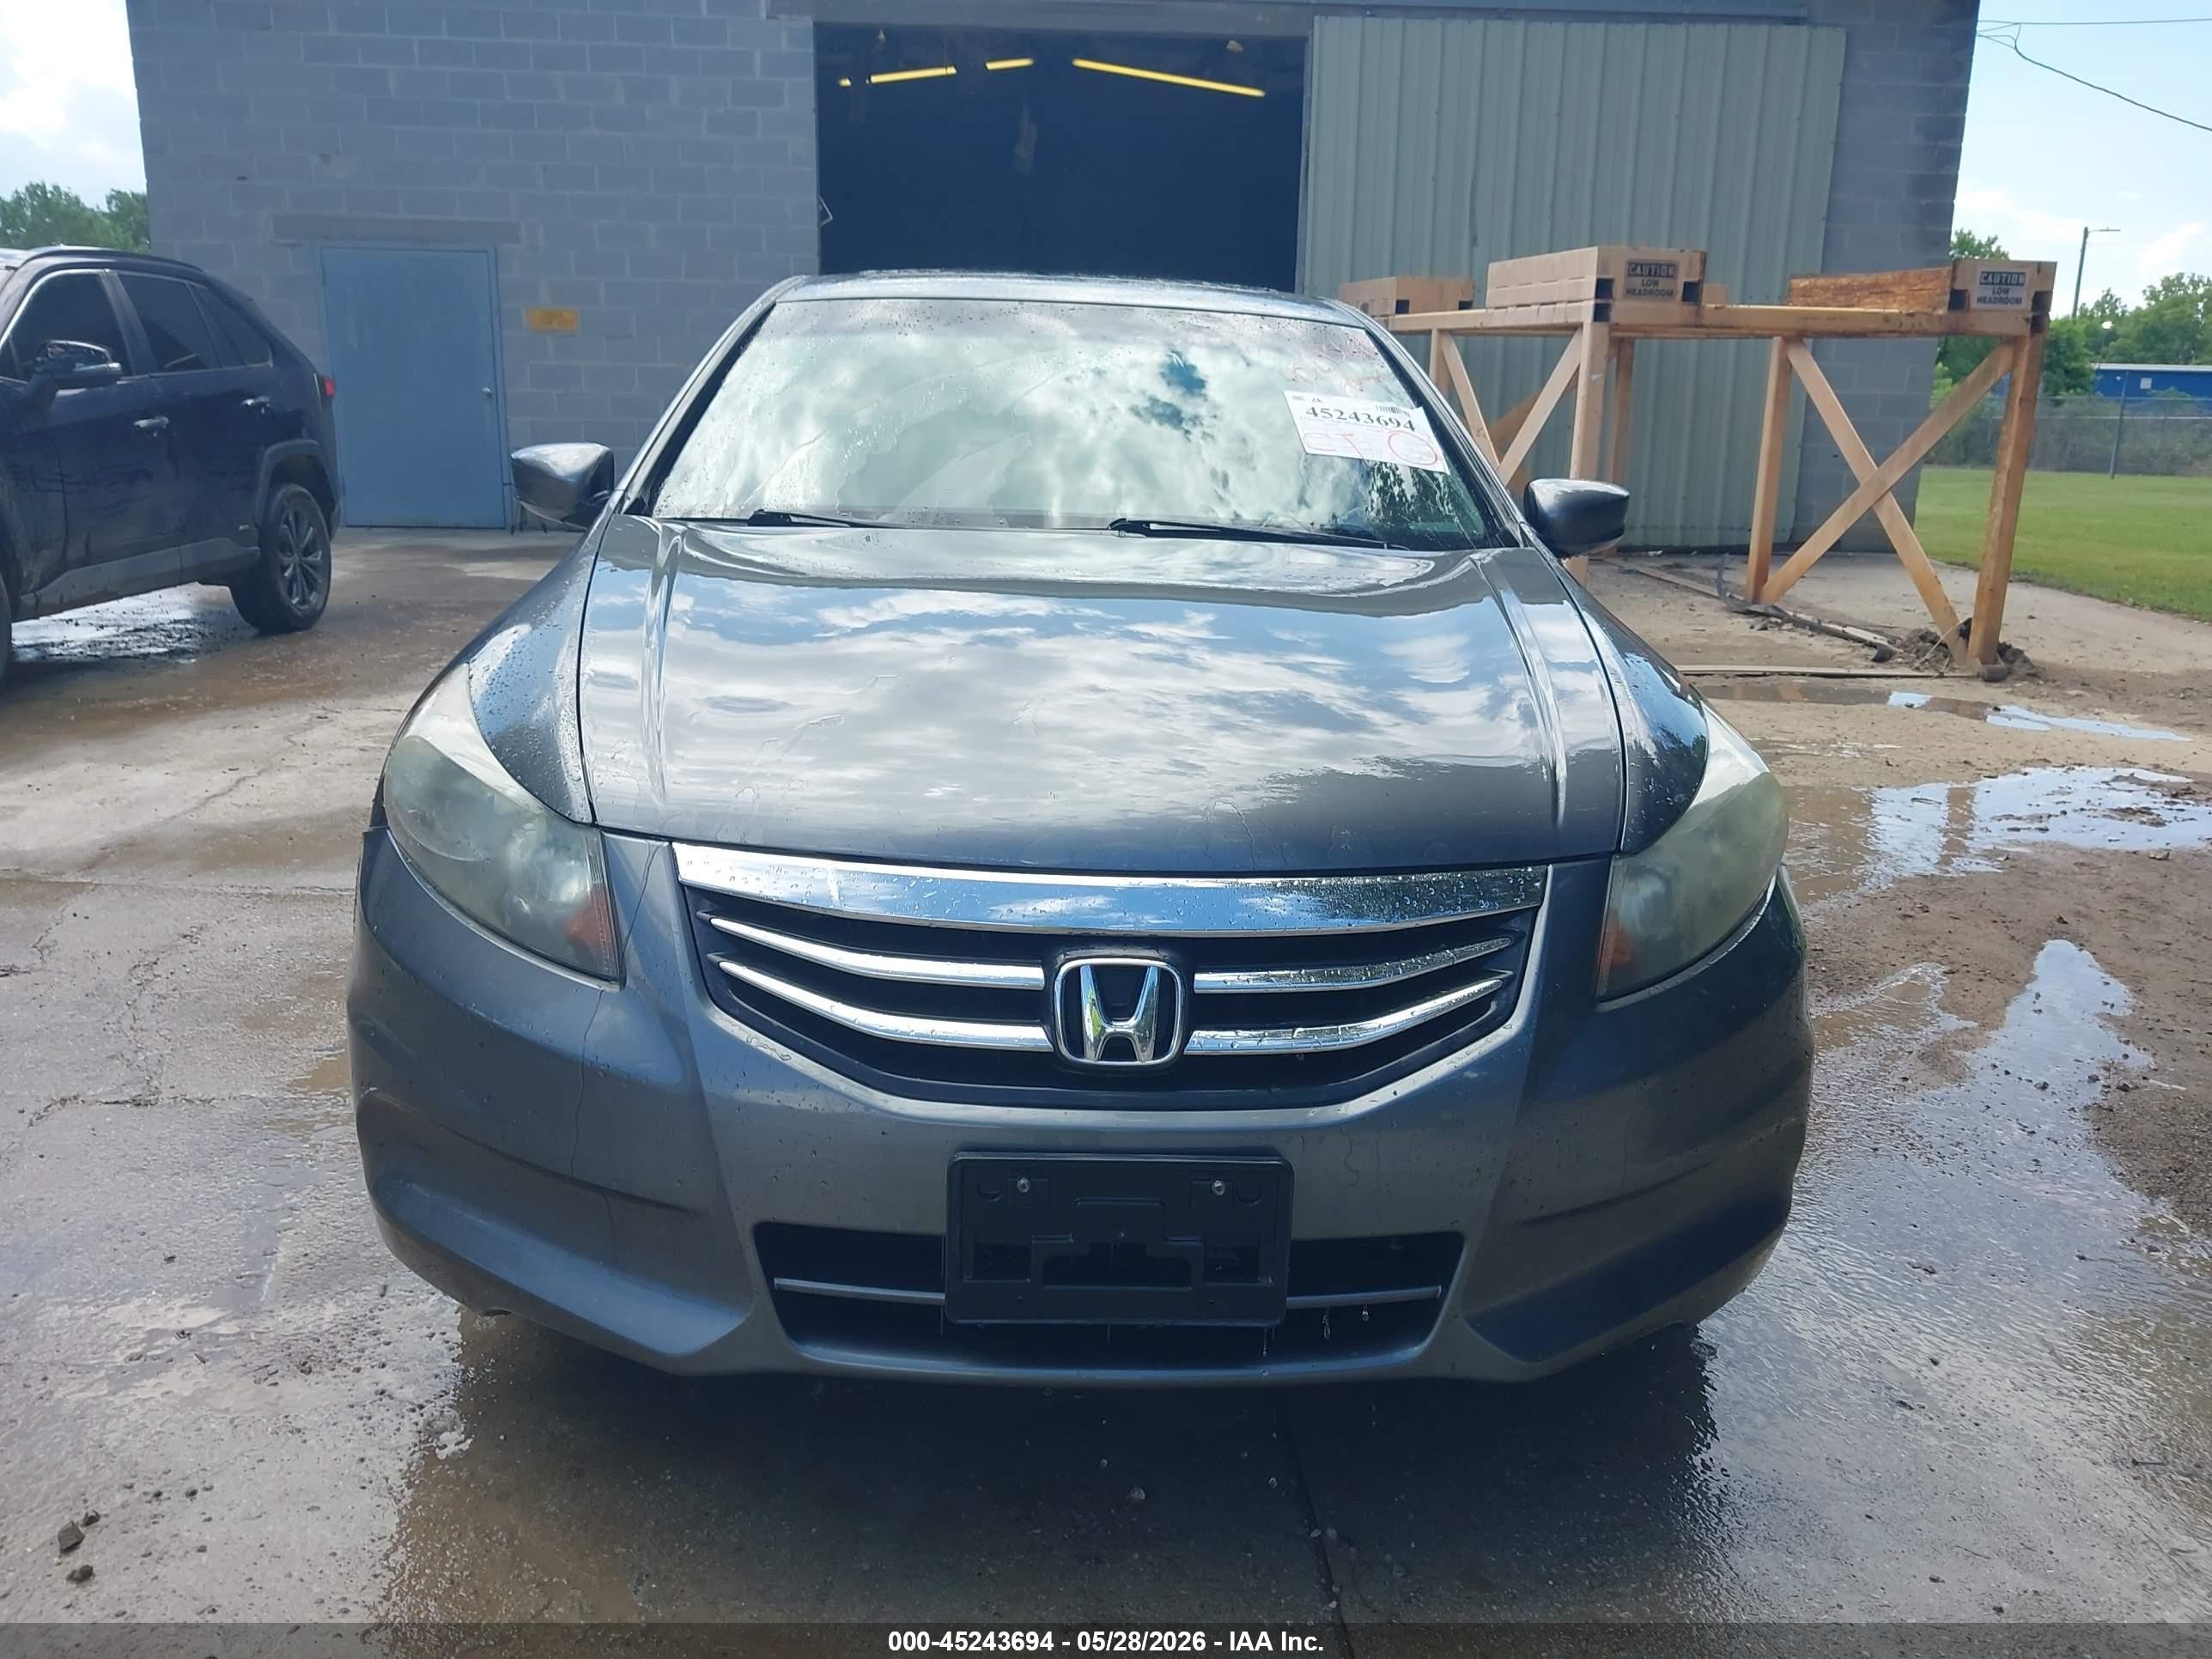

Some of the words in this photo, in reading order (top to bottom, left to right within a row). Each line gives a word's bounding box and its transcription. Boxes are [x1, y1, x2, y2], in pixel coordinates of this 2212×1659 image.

[1628, 264, 1676, 276] CAUTION
[1641, 278, 1659, 288] LOW
[1980, 272, 2025, 285] CAUTION
[1626, 288, 1674, 297] HEADROOM
[1992, 287, 2010, 295] LOW
[1977, 295, 2022, 305] HEADROOM
[1305, 406, 1416, 432] 45243694
